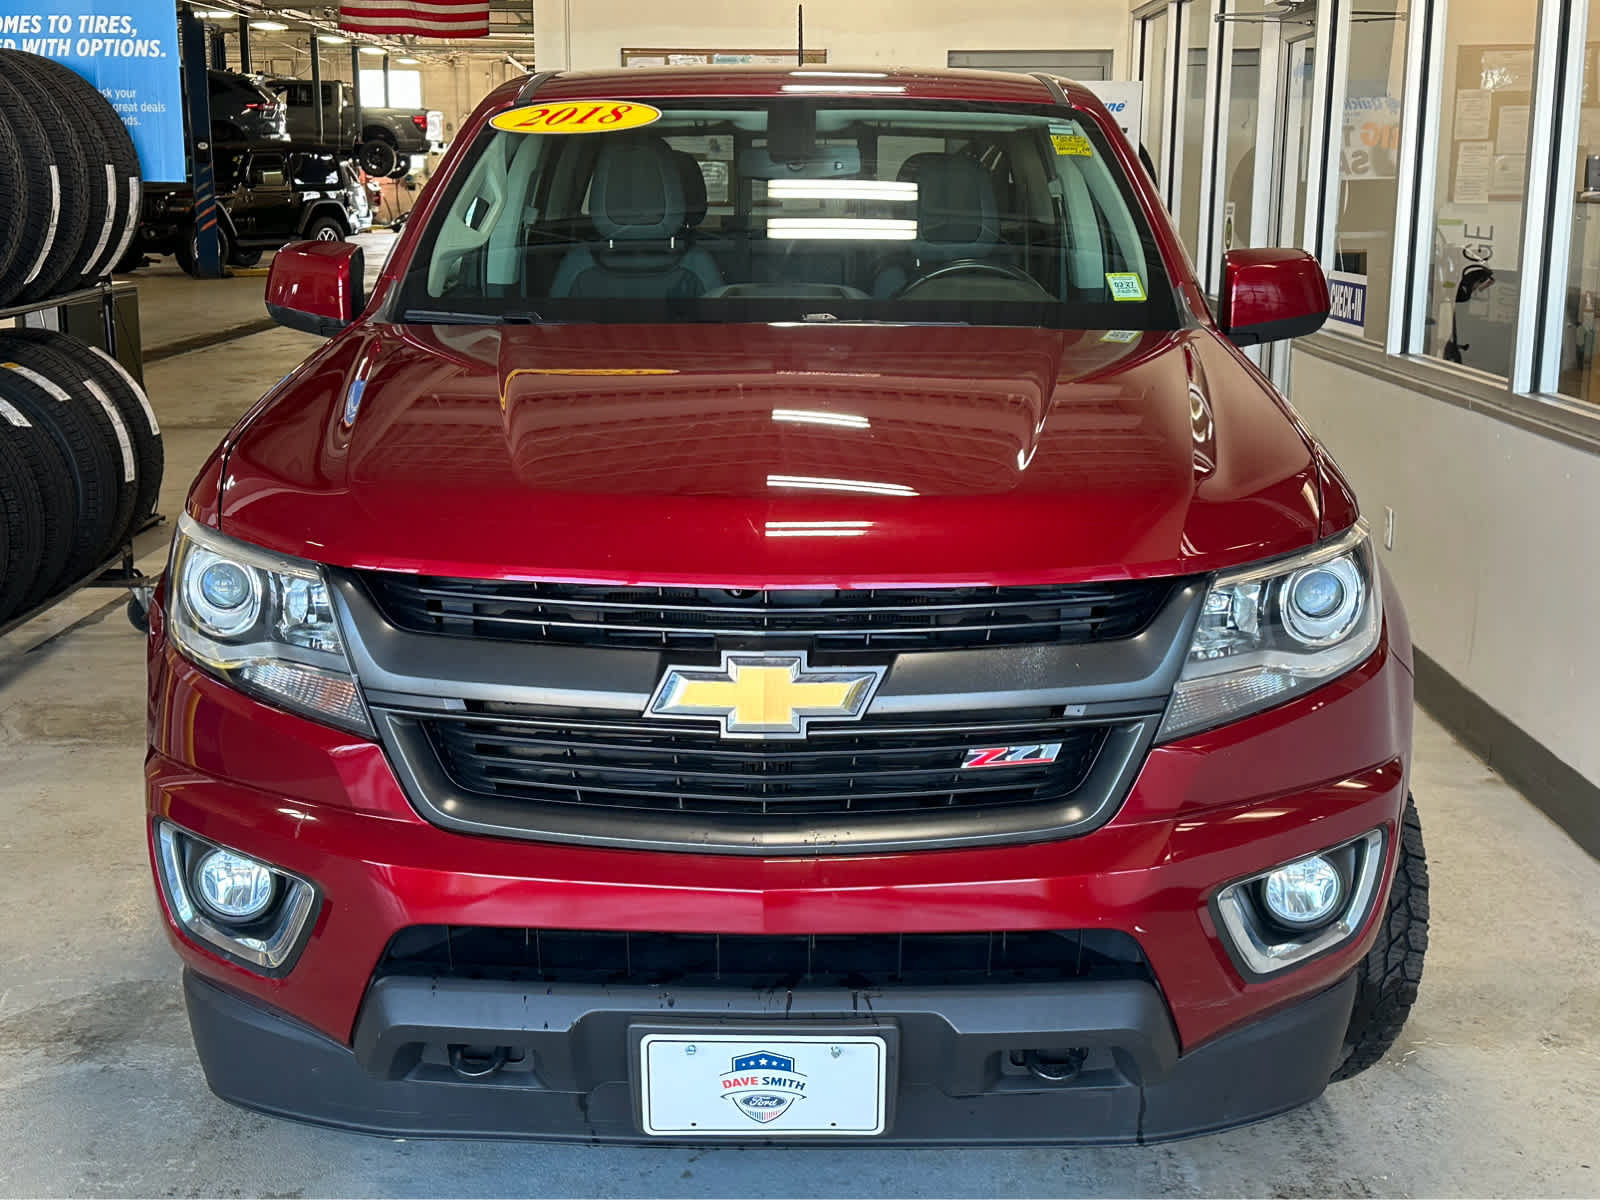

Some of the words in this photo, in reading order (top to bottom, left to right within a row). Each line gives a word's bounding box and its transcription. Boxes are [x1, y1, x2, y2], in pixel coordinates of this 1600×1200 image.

[0, 16, 42, 34] MES
[48, 15, 73, 34] TO
[78, 15, 137, 37] TIRES,
[22, 38, 70, 57] WITH
[76, 39, 167, 58] OPTIONS.
[115, 89, 137, 101] your
[112, 102, 139, 113] great
[140, 102, 166, 113] deals
[1103, 102, 1126, 113] ne
[513, 105, 633, 128] 2018
[1330, 282, 1363, 322] CHECK-IN
[961, 743, 1063, 769] Z71
[722, 1076, 759, 1089] DAVE
[762, 1076, 806, 1091] SMITH
[748, 1096, 779, 1108] Ford
